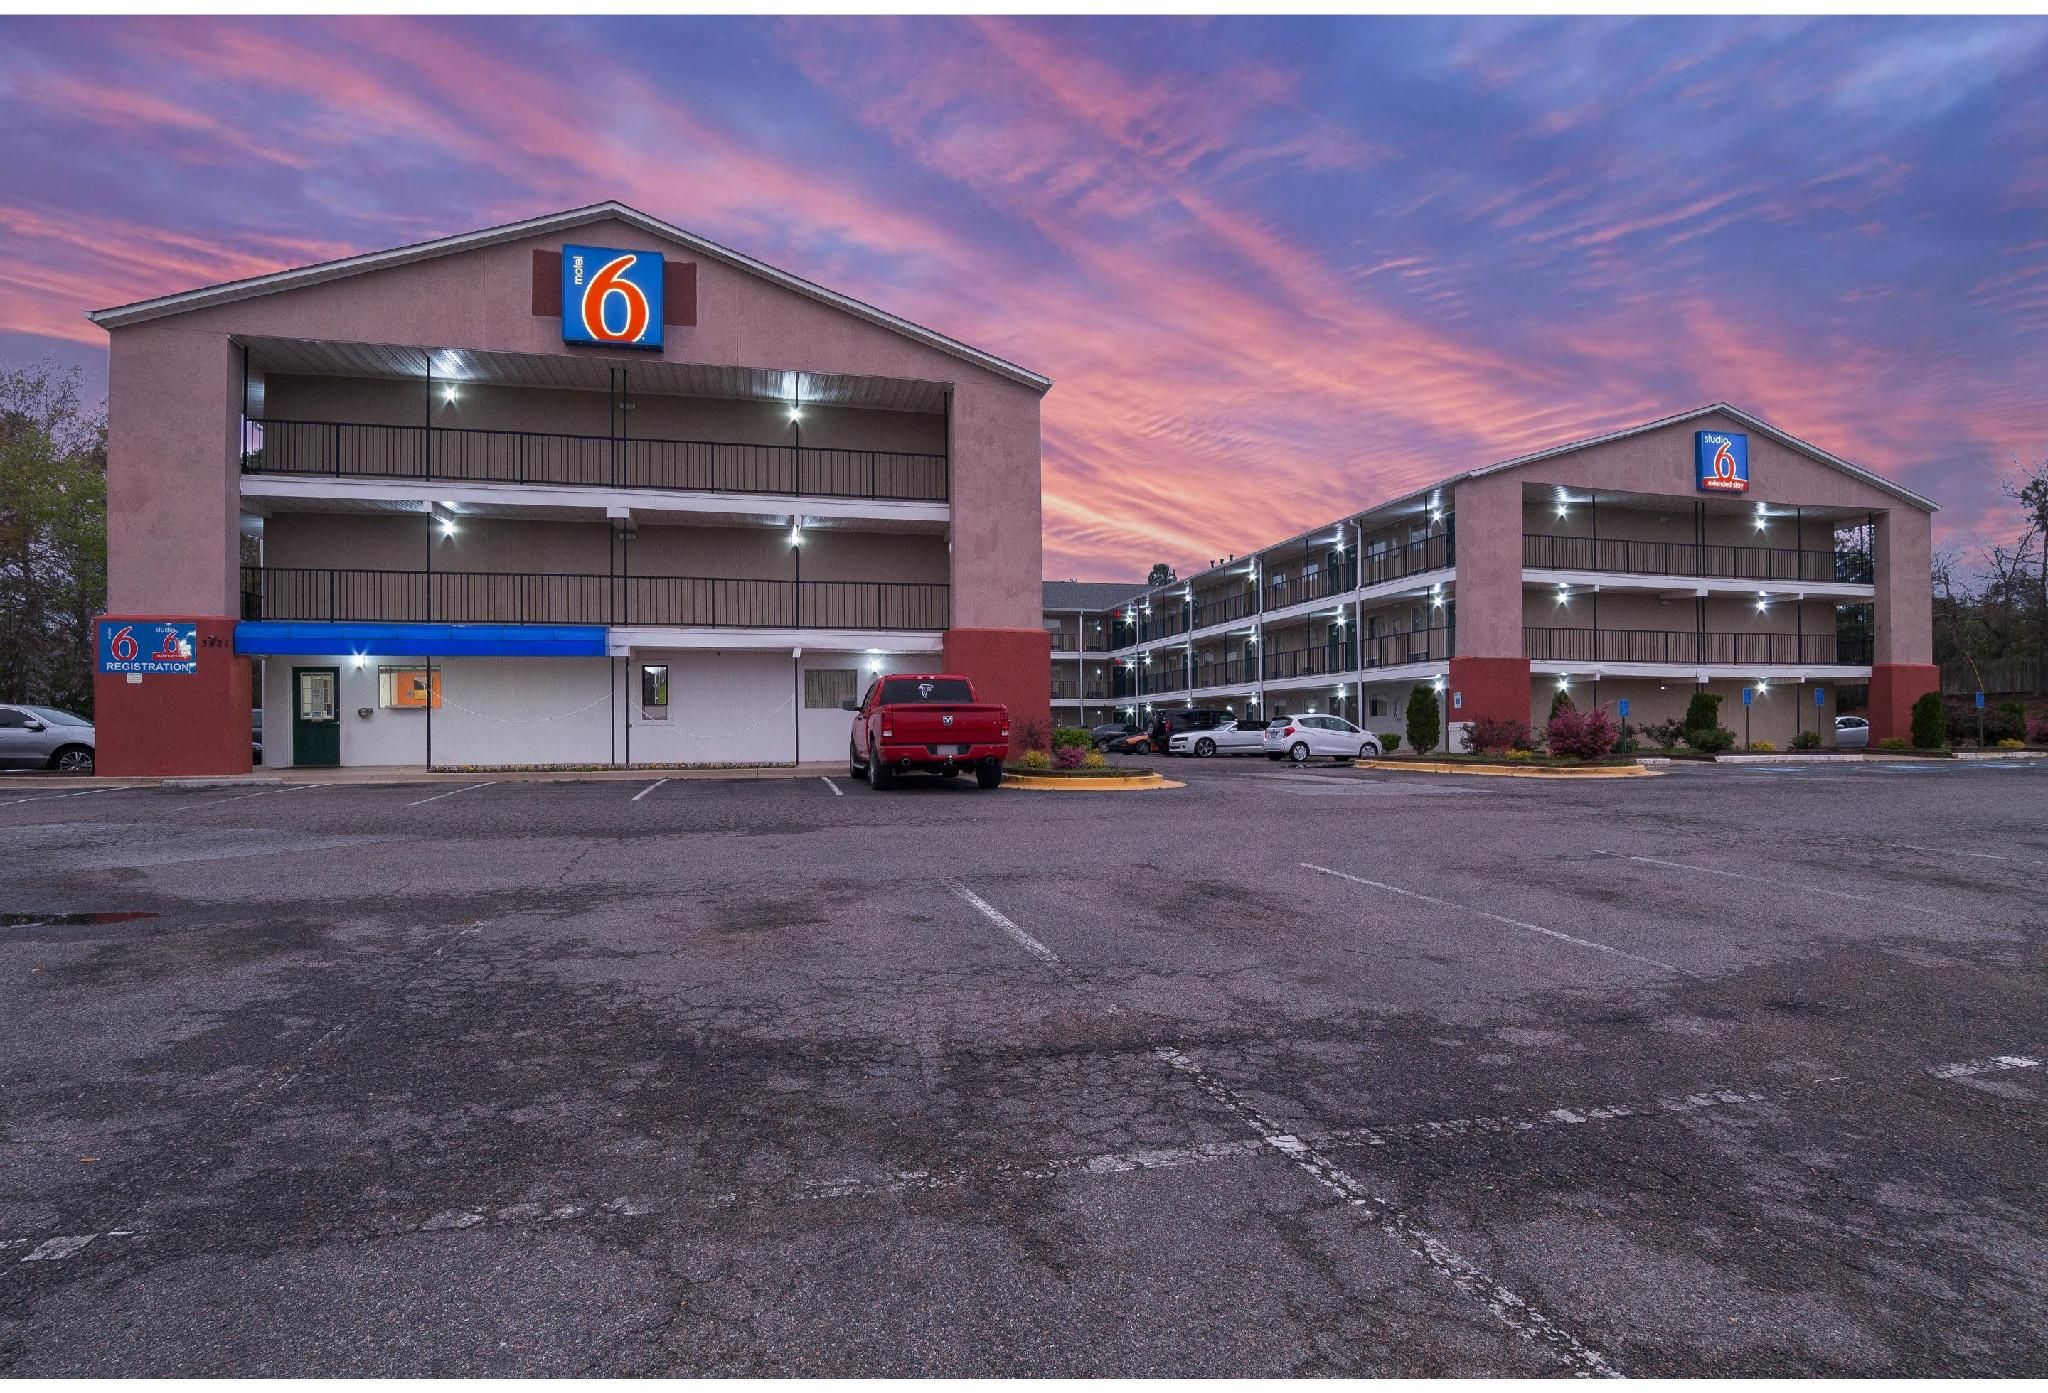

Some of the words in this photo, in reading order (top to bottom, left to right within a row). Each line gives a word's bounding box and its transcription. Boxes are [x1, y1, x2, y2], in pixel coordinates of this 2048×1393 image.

[573, 256, 584, 285] motel
[581, 254, 650, 343] 6
[1704, 434, 1729, 444] studio
[1713, 441, 1737, 479] 6
[111, 625, 139, 661] 6
[163, 629, 181, 654] 6
[106, 662, 189, 672] REGISTRATION
